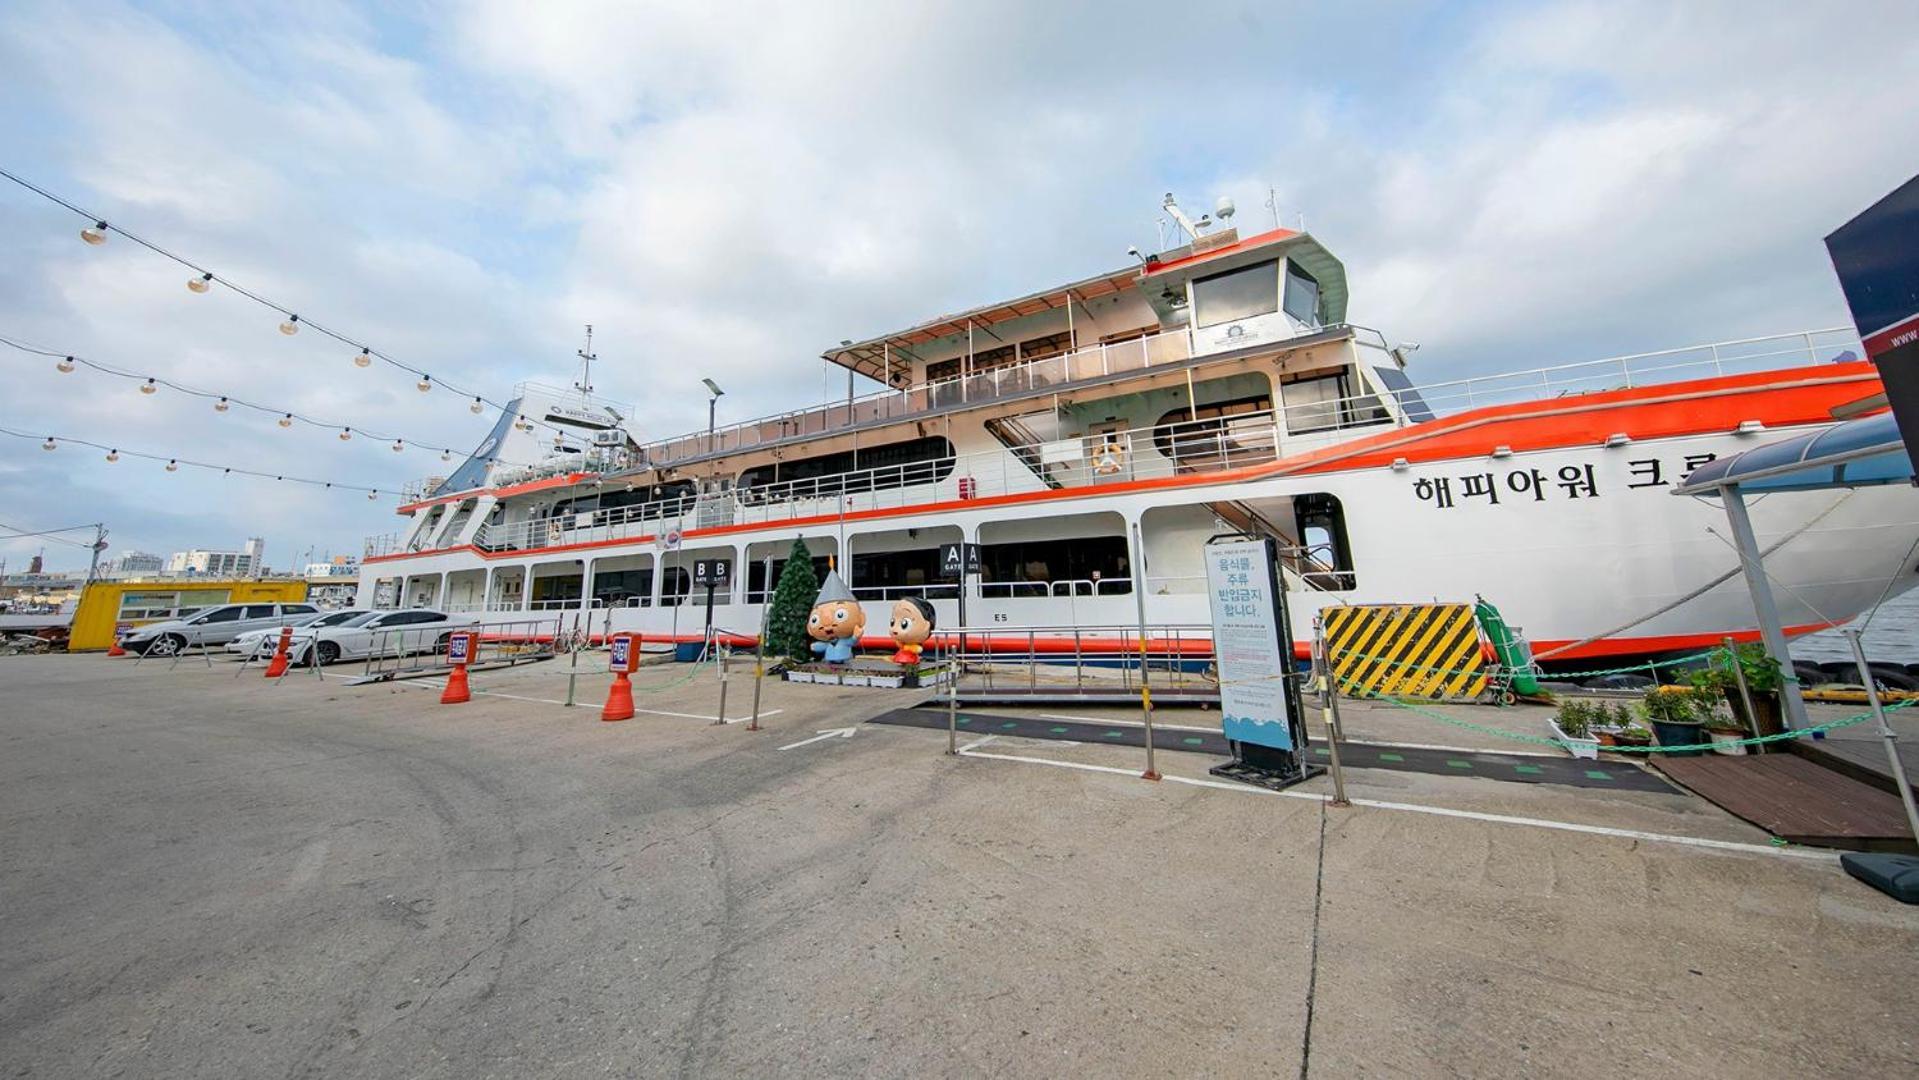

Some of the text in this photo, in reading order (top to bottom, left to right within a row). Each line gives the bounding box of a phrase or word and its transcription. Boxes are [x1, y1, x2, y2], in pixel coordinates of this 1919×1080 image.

[1412, 463, 1600, 509] 해피아워
[947, 546, 959, 562] A
[969, 546, 977, 561] A
[698, 563, 706, 576] B
[716, 563, 724, 575] B
[1228, 574, 1248, 586] 주류
[1219, 589, 1262, 602] 반입금지
